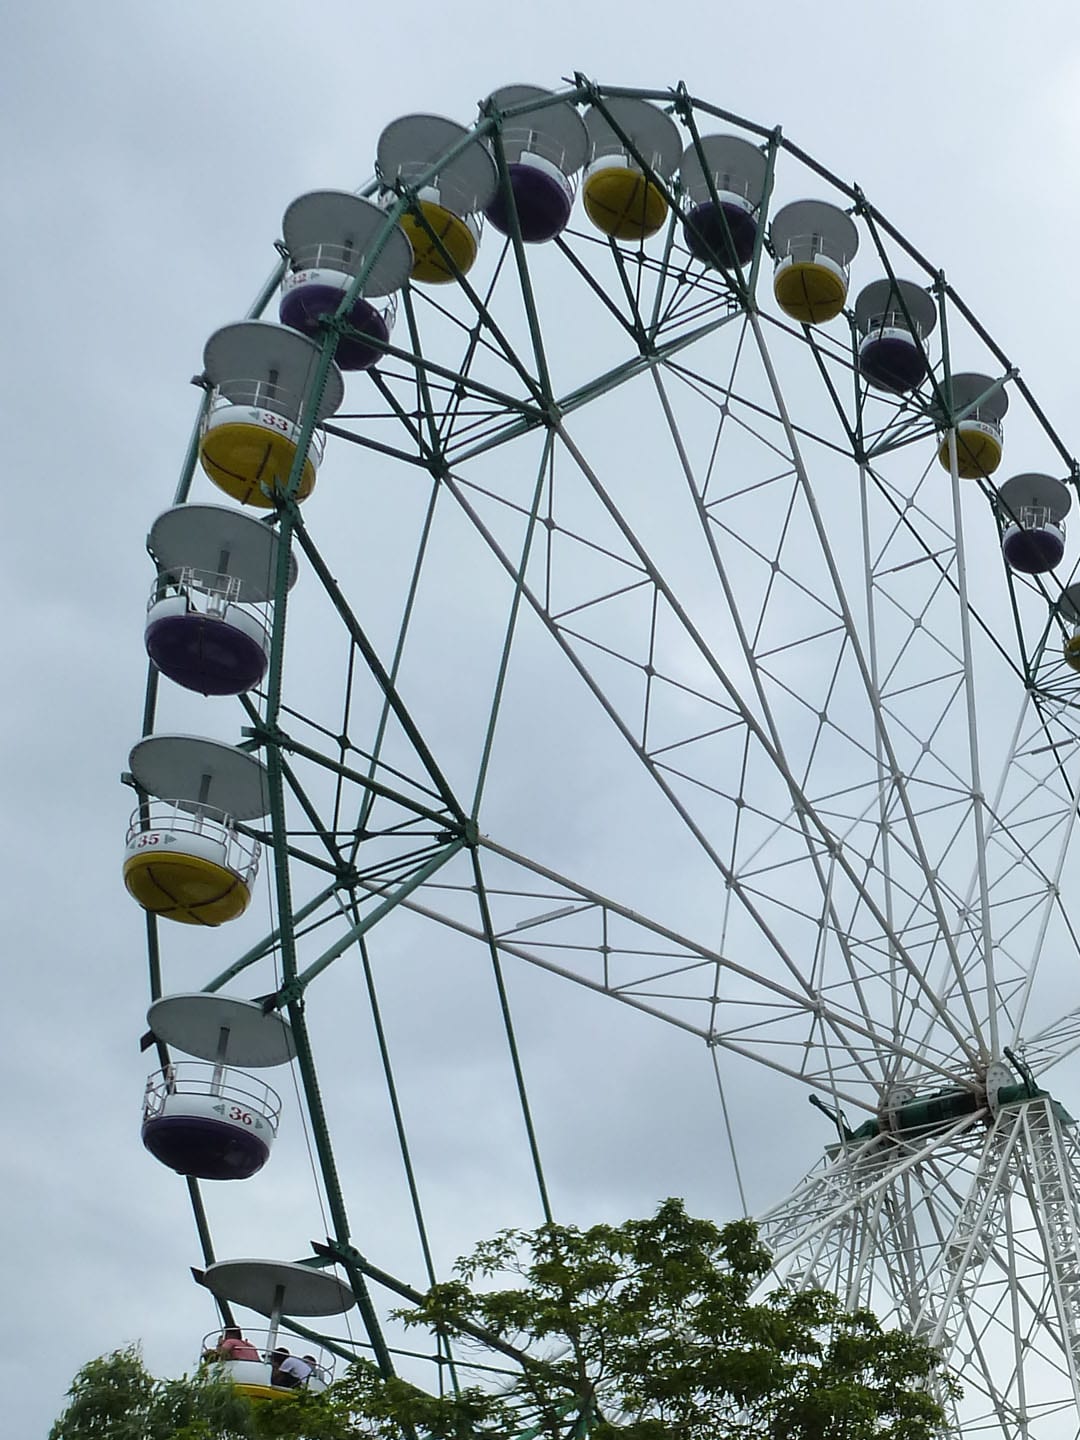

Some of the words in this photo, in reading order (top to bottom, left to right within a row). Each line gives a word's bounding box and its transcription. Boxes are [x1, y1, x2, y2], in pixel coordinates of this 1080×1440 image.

[262, 413, 288, 431] 33
[137, 833, 160, 848] 35
[229, 1106, 252, 1125] 36
